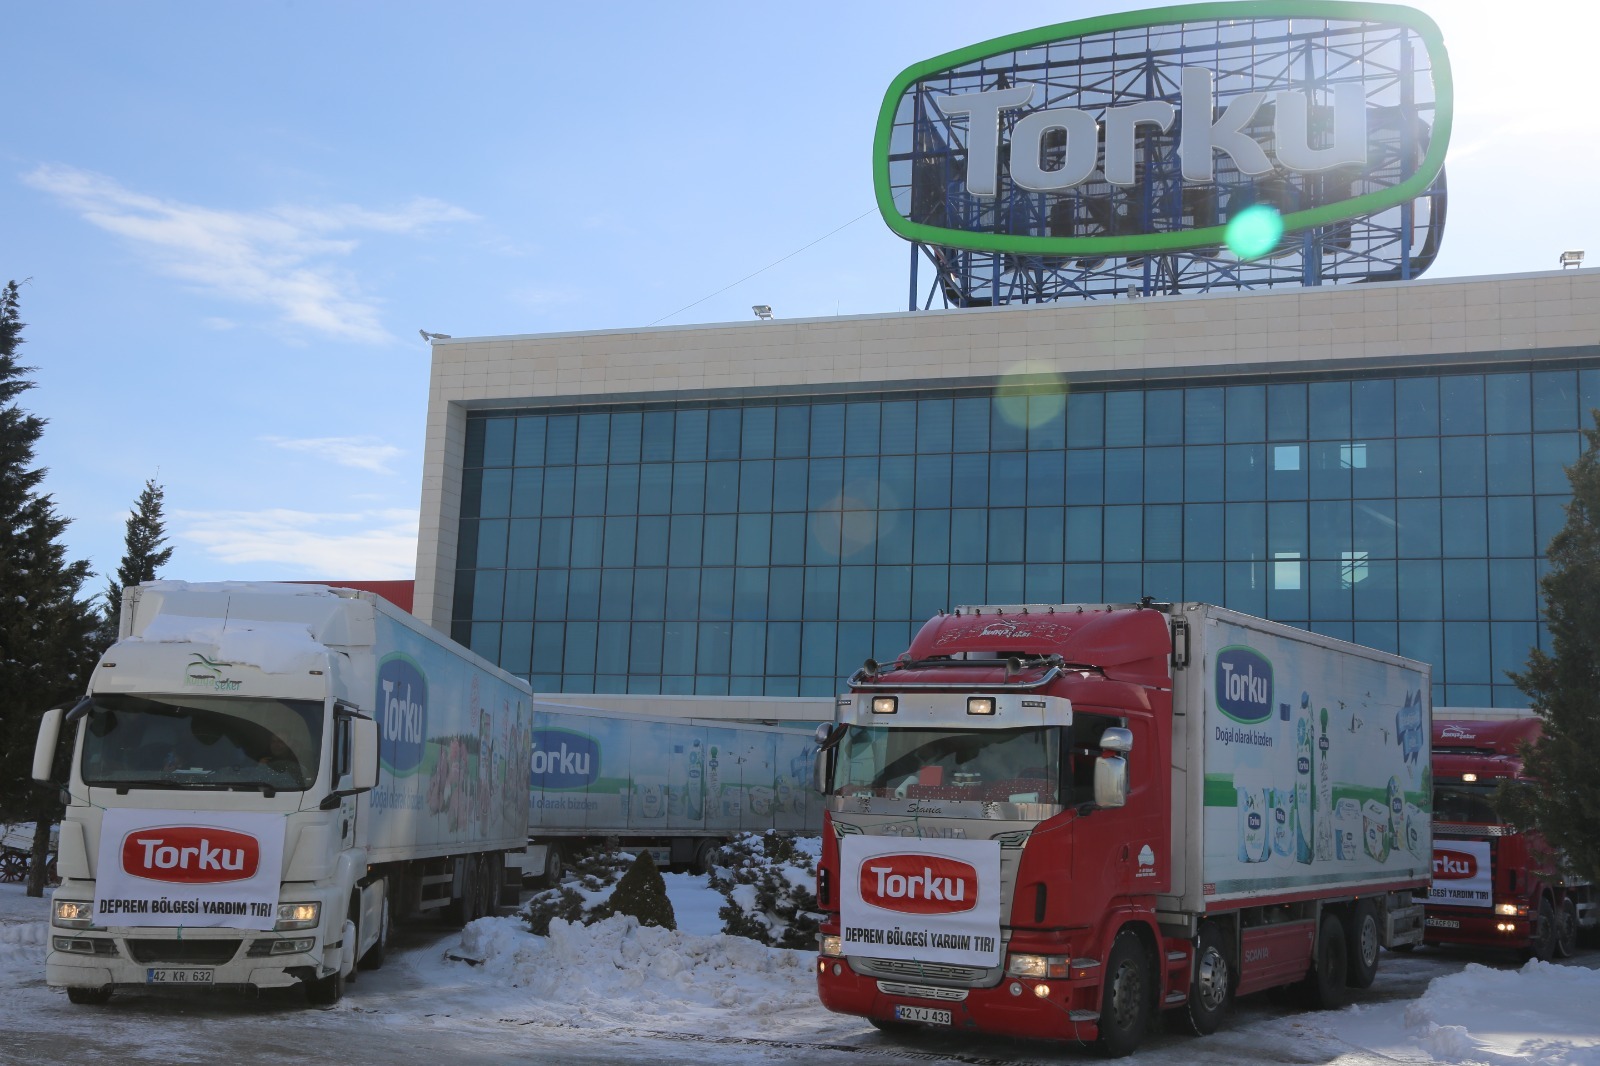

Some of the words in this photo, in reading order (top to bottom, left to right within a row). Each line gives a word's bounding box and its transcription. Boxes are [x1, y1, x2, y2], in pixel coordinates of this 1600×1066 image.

[936, 66, 1368, 197] Torku
[1221, 661, 1267, 704] Torku
[382, 678, 423, 744] Torku
[1215, 726, 1234, 746] Doğal
[1234, 728, 1253, 745] olarak
[1254, 730, 1273, 747] bizden
[531, 742, 590, 775] orku
[907, 803, 943, 814] Scania
[137, 838, 244, 870] Torku
[1433, 855, 1470, 874] rku
[870, 866, 965, 902] Torku
[1429, 887, 1447, 898] LGESİ
[1448, 890, 1474, 899] YARDIM
[1476, 891, 1489, 900] TIRI
[99, 899, 148, 914] DEPREM
[152, 896, 199, 914] BÖLGESİ
[203, 901, 247, 916] YARDIM
[250, 902, 273, 918] TIRI
[845, 927, 884, 945] DEPREM
[887, 926, 928, 948] BÖLGESİ
[930, 933, 971, 951] YARDIM
[973, 936, 995, 953] TIRI
[1245, 946, 1269, 963] SCANIA
[154, 971, 166, 981] 42
[173, 971, 185, 981] KR
[192, 971, 211, 982] 632
[900, 1007, 911, 1019] 42
[932, 1011, 950, 1023] 433
